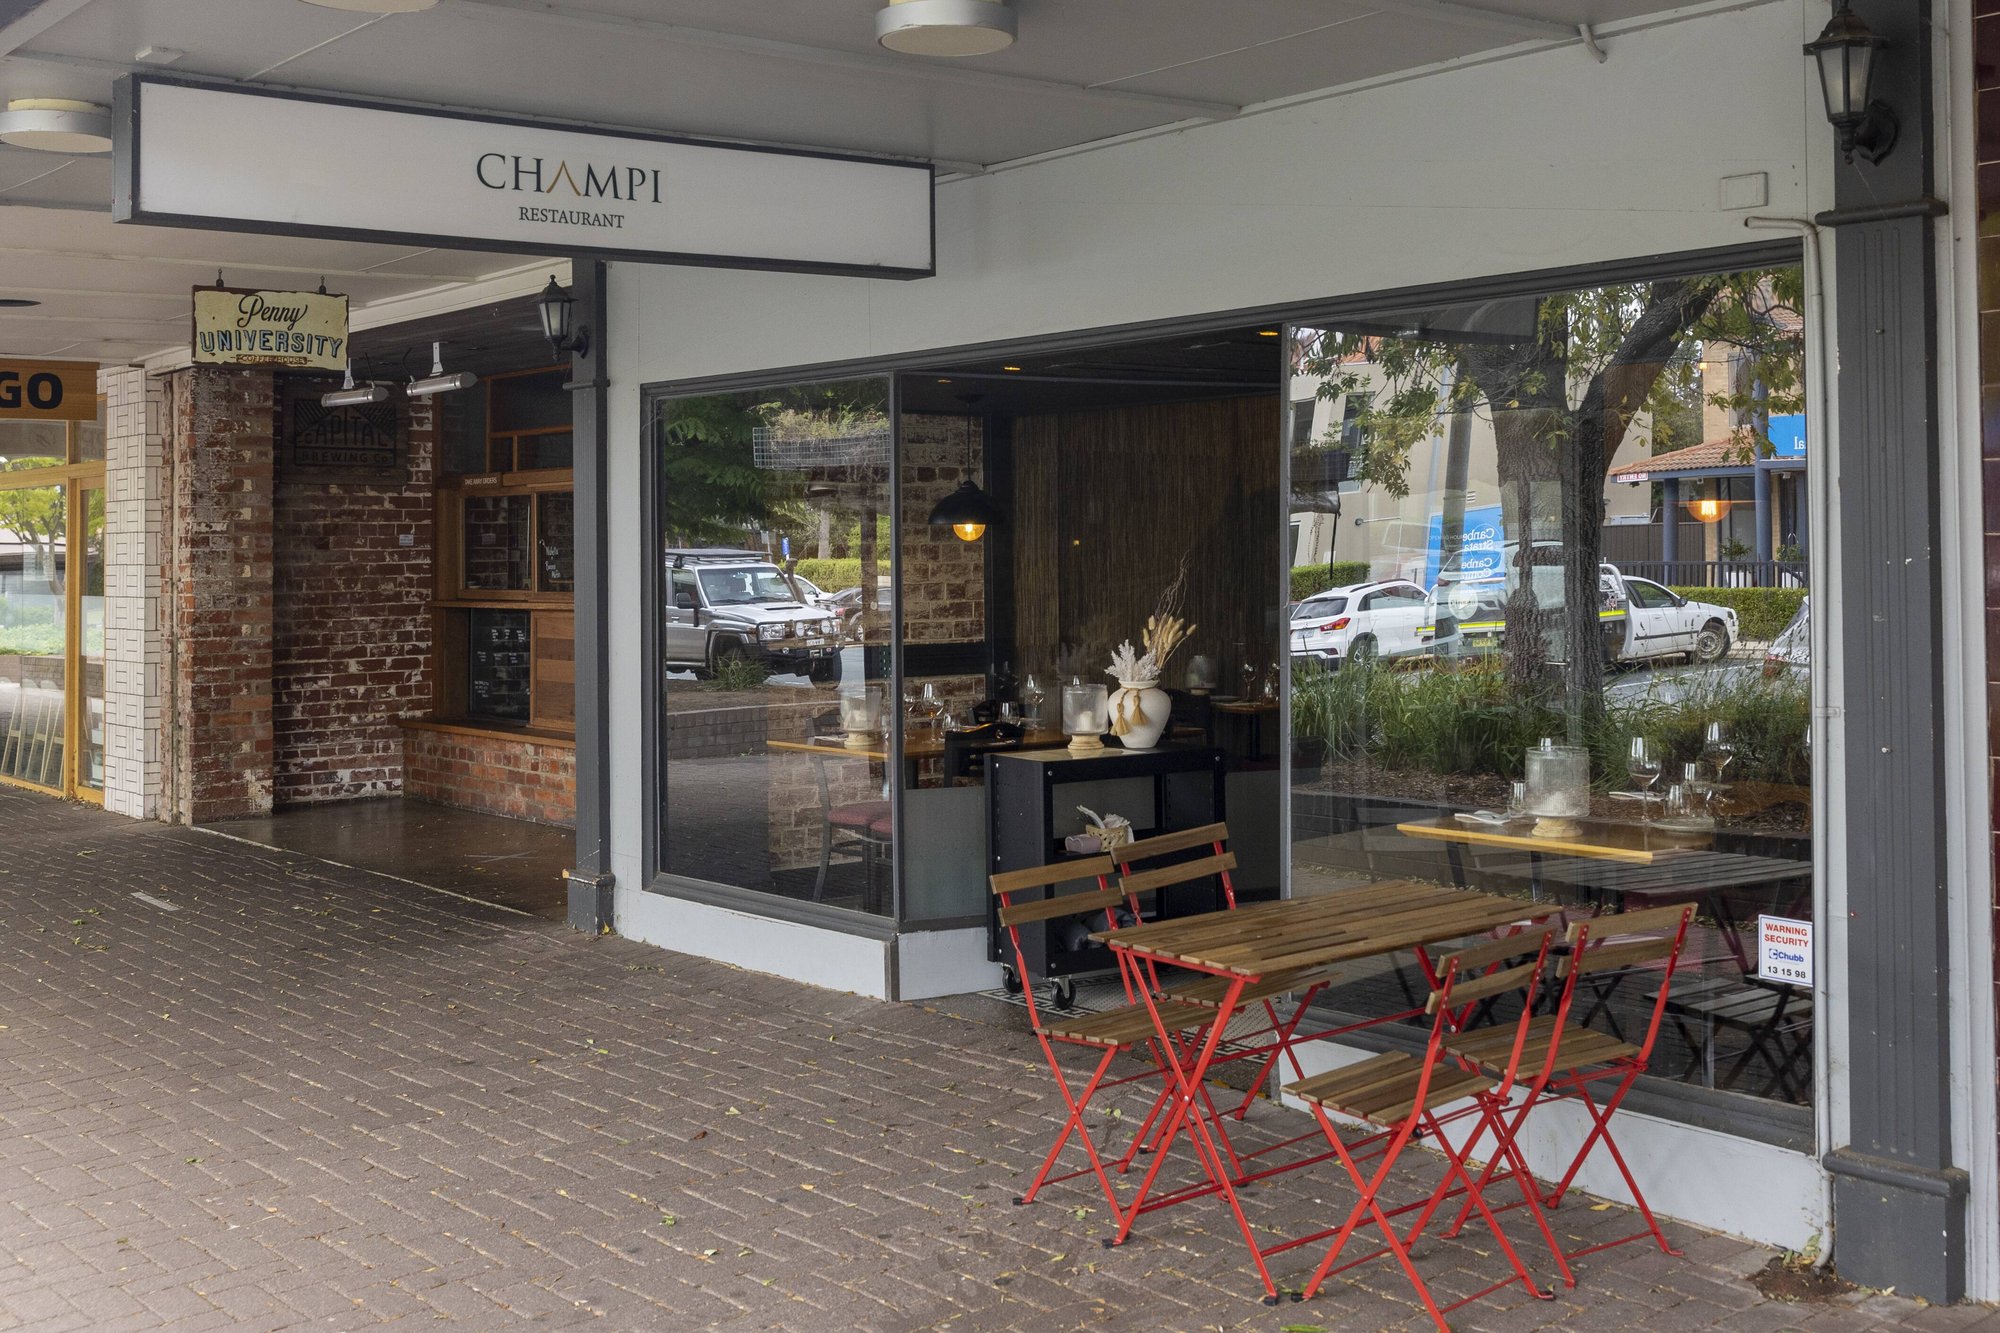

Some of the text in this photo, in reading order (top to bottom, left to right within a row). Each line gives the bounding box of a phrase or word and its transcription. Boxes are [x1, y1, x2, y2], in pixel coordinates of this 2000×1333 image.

[476, 152, 662, 203] CHAMPI
[518, 206, 624, 228] RESTAURANT
[237, 294, 308, 331] Penny
[200, 329, 343, 358] UNIVERSITY
[0, 371, 63, 409] GO
[304, 406, 388, 447] CAPITAL
[302, 450, 368, 464] BREWING
[1764, 934, 1808, 947] SECURITY
[1765, 923, 1807, 936] WARNING
[1778, 951, 1804, 962] Chubb
[1768, 966, 1806, 978] 13 15 98
